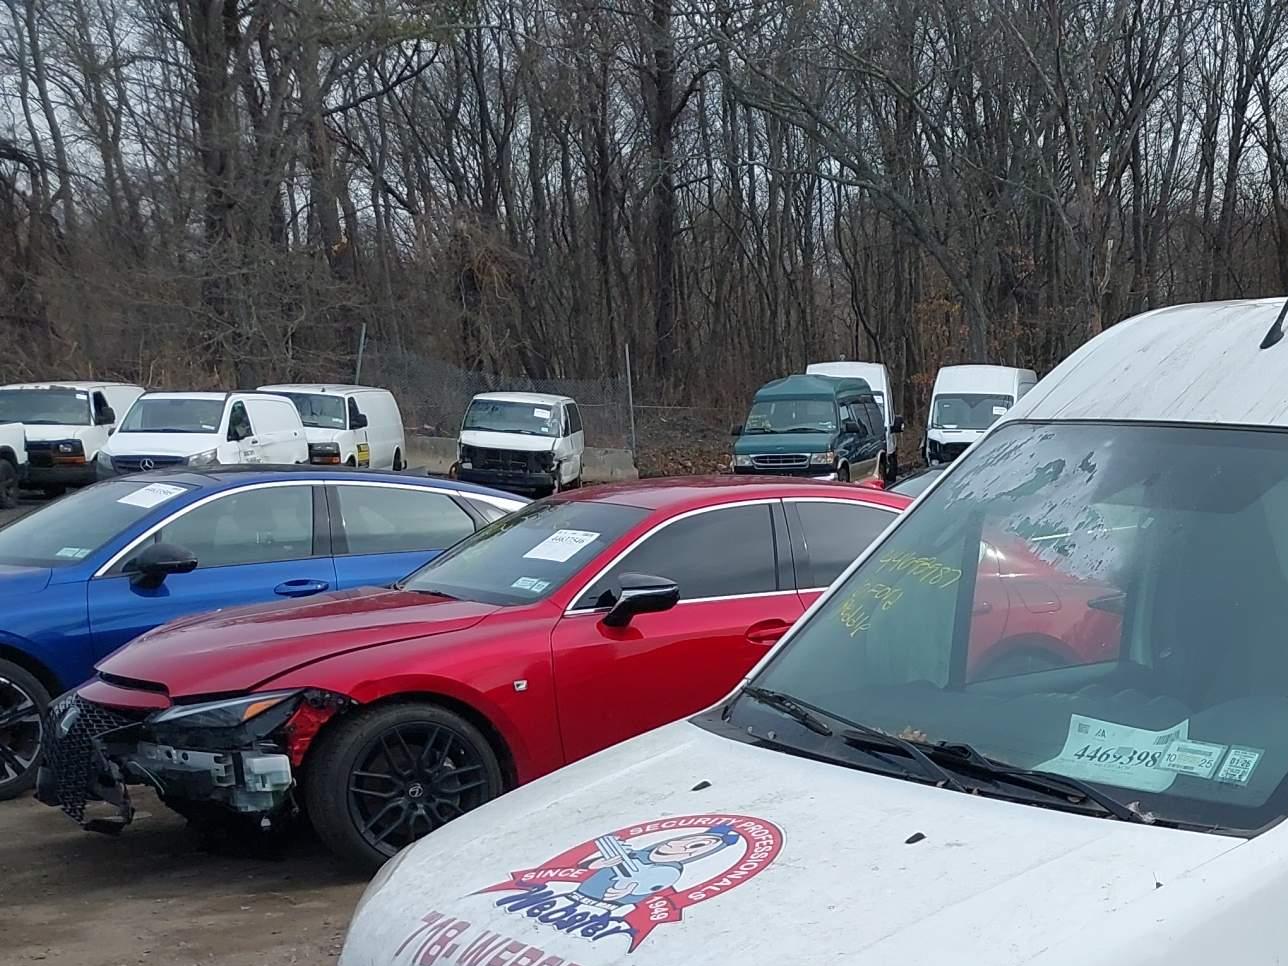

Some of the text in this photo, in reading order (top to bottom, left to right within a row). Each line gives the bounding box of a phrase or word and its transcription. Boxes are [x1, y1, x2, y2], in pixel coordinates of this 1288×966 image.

[1200, 758, 1214, 769] 25
[629, 816, 776, 901] SECURITY PROFESSIONALS
[522, 868, 588, 882] SINCE
[496, 882, 638, 941] Webster
[646, 896, 670, 921] 1949
